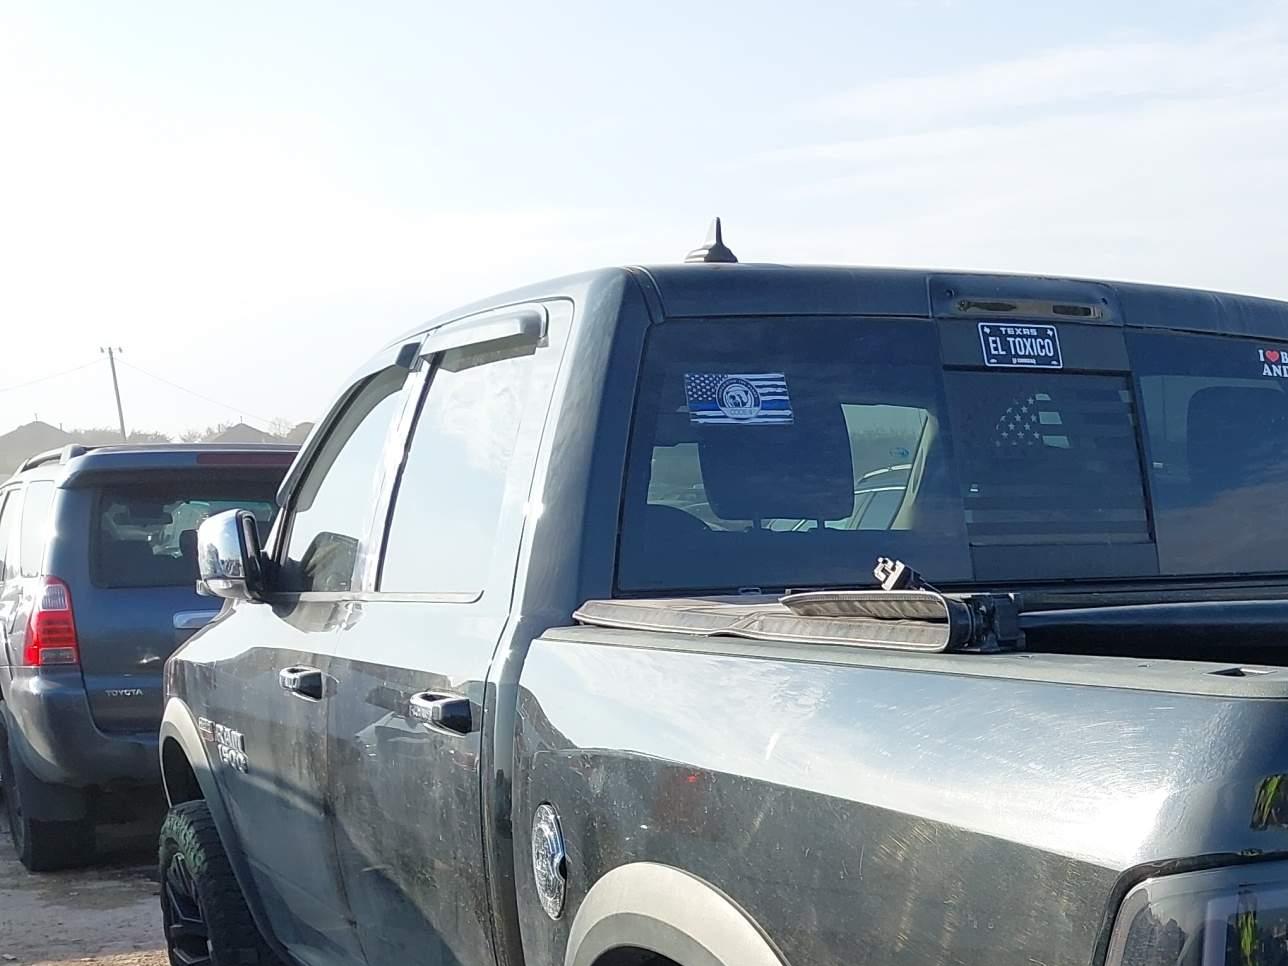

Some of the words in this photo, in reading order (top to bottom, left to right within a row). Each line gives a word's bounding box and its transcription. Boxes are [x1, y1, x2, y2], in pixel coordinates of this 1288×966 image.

[1000, 327, 1037, 336] TEXAS
[989, 337, 1006, 355] EL
[1007, 337, 1054, 356] TOXICO
[1258, 349, 1265, 362] I
[105, 688, 144, 697] TOYOTA
